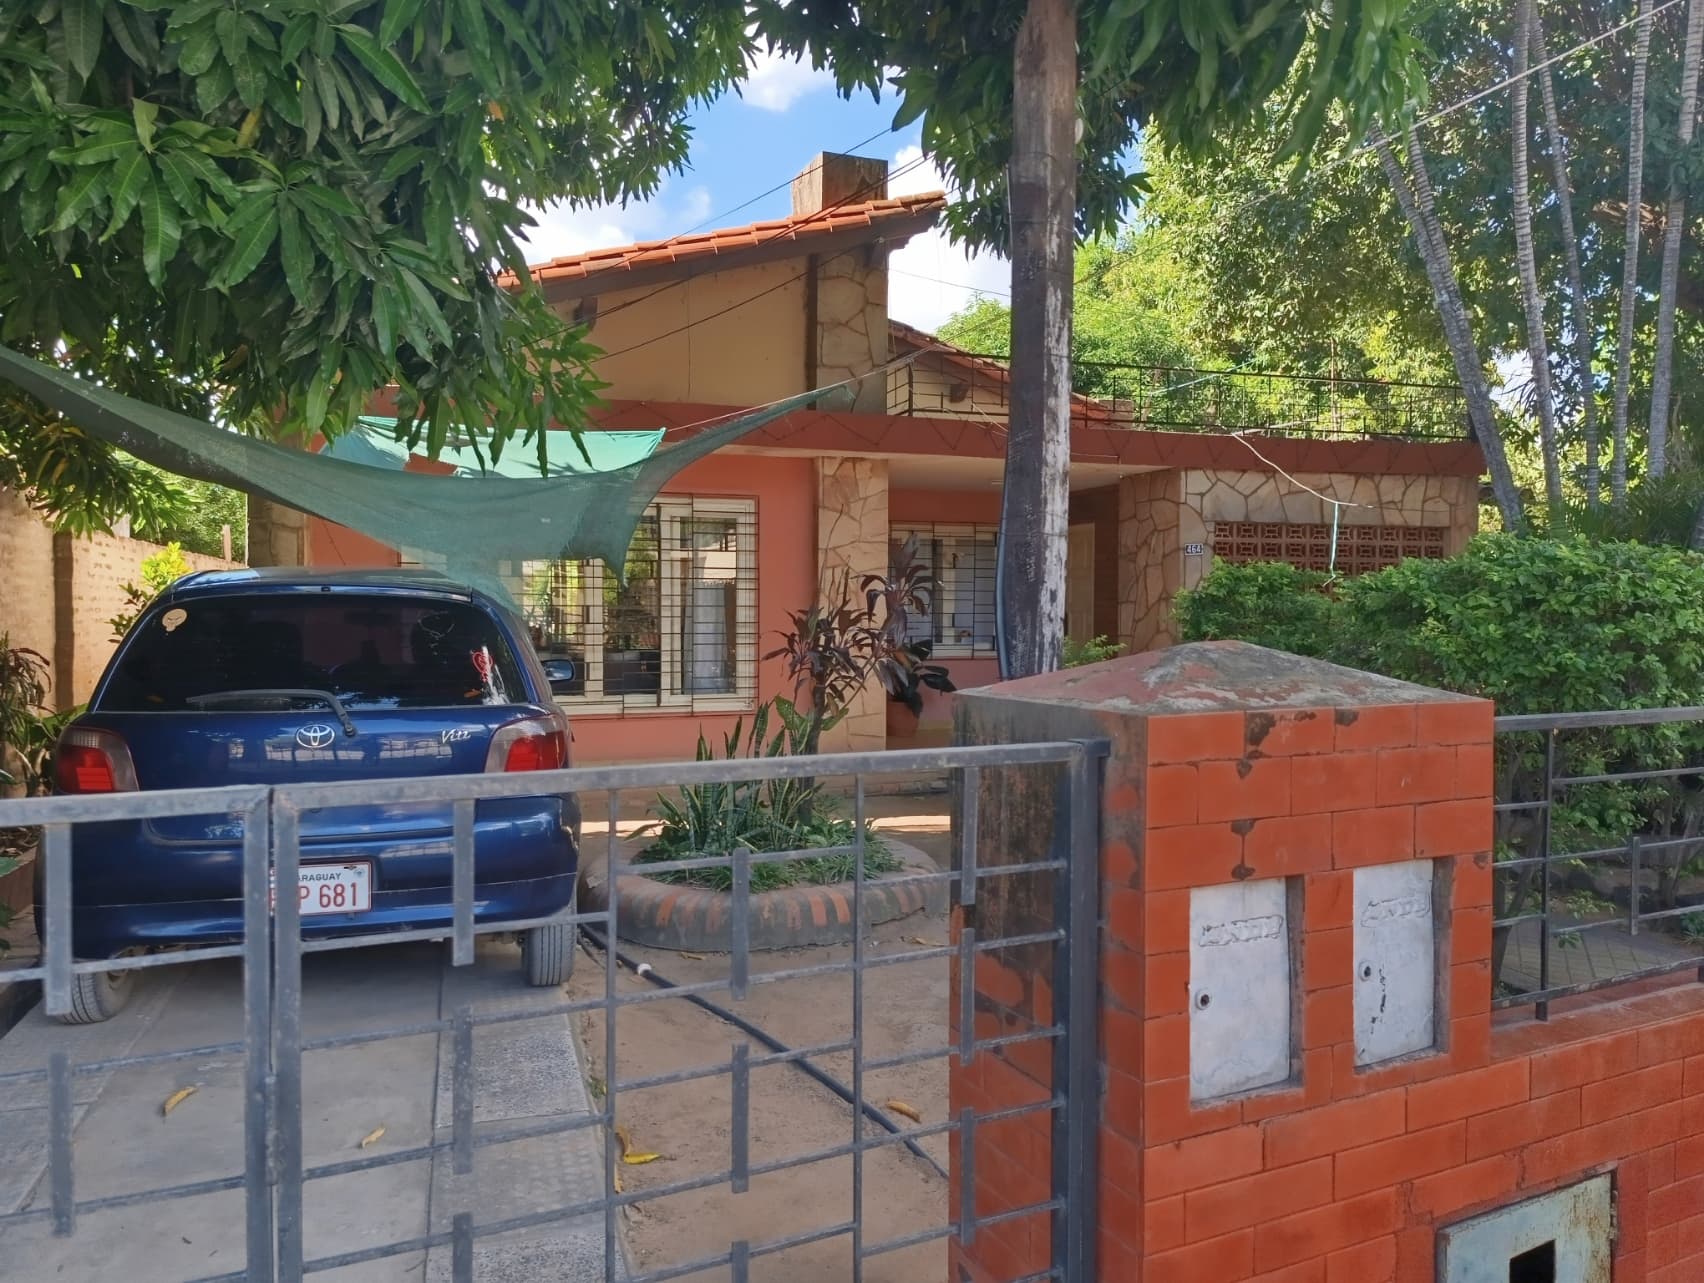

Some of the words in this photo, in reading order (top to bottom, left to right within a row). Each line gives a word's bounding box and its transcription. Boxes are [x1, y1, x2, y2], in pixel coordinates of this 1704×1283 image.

[441, 728, 471, 744] Vitz
[298, 872, 342, 881] RAGUAY
[319, 882, 357, 908] 681
